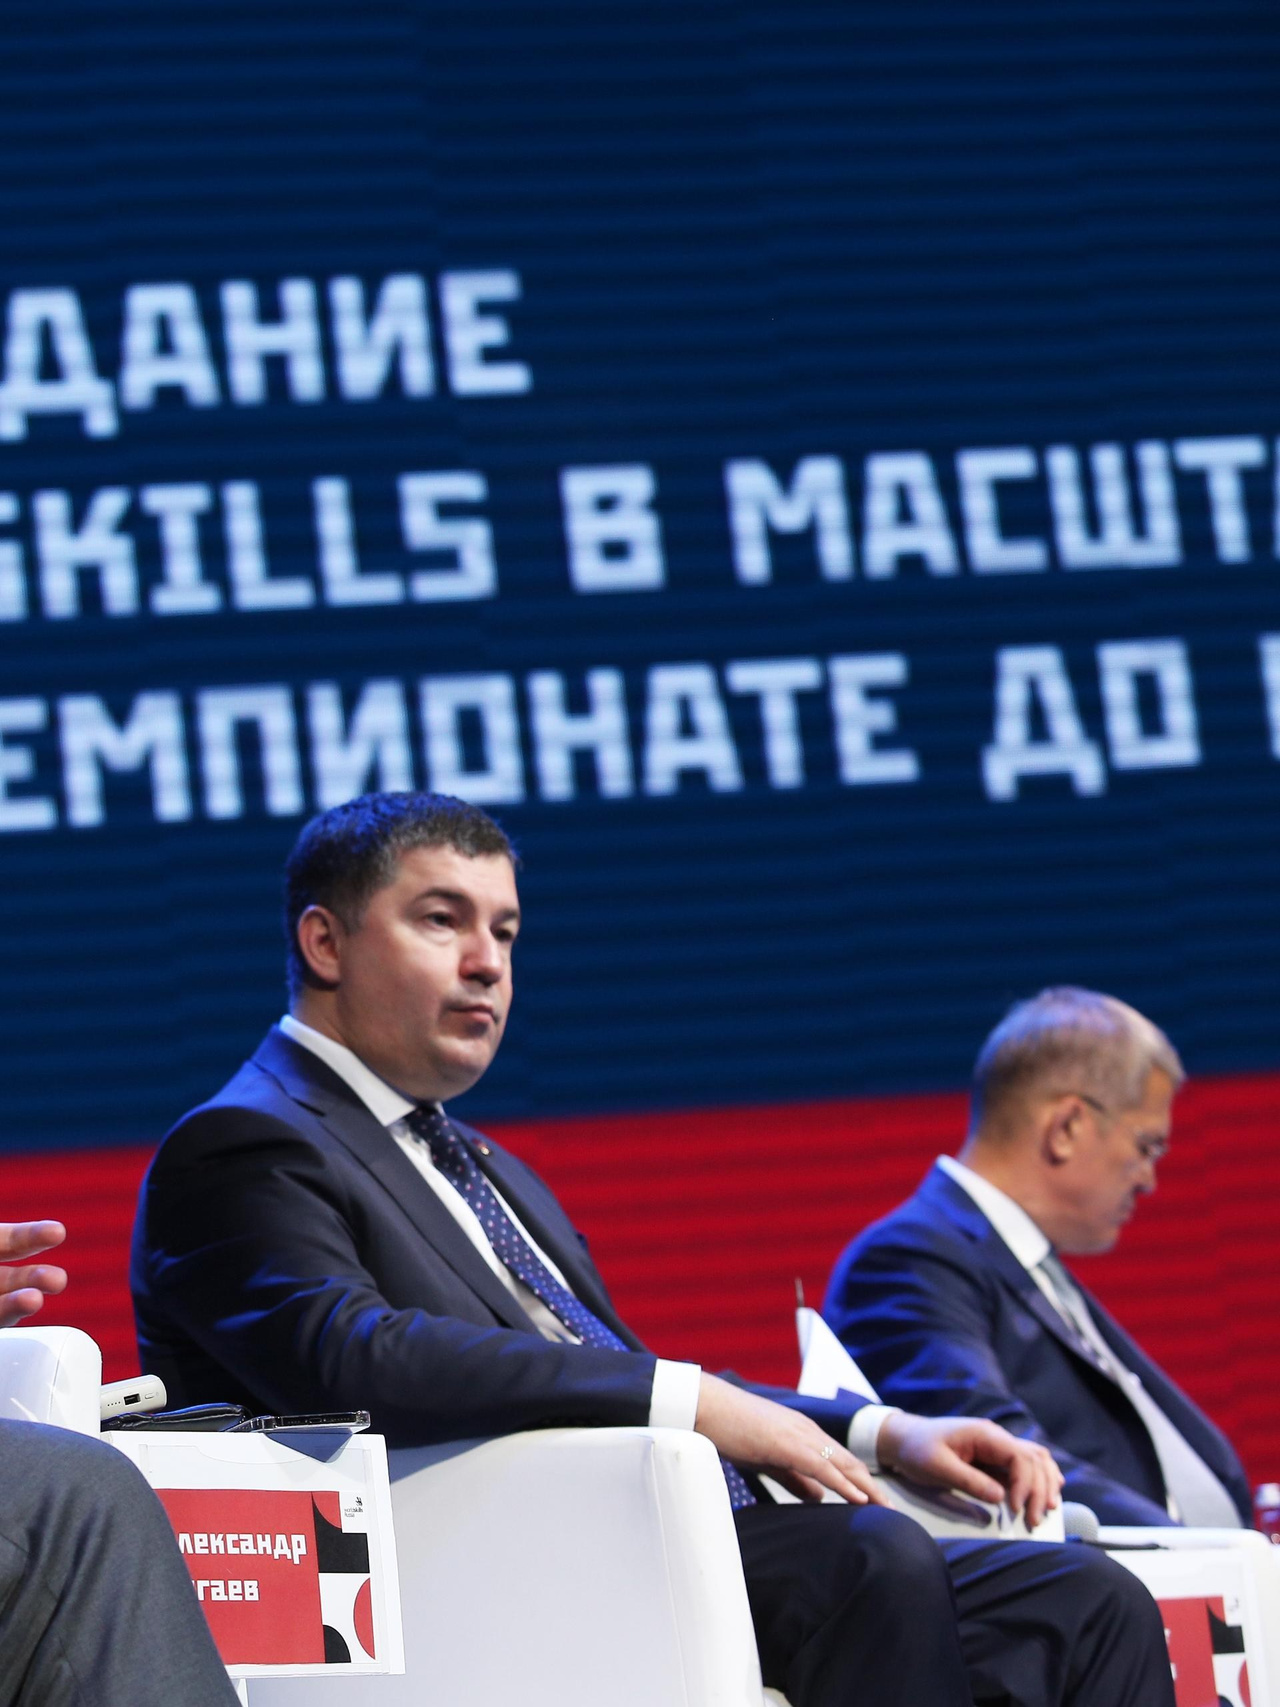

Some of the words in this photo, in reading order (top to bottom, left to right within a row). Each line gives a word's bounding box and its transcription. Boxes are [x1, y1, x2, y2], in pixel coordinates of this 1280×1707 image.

[560, 463, 665, 594] В
[724, 433, 1280, 587] МАСШТ
[982, 637, 1202, 801] ДО
[192, 1580, 259, 1601] гаев
